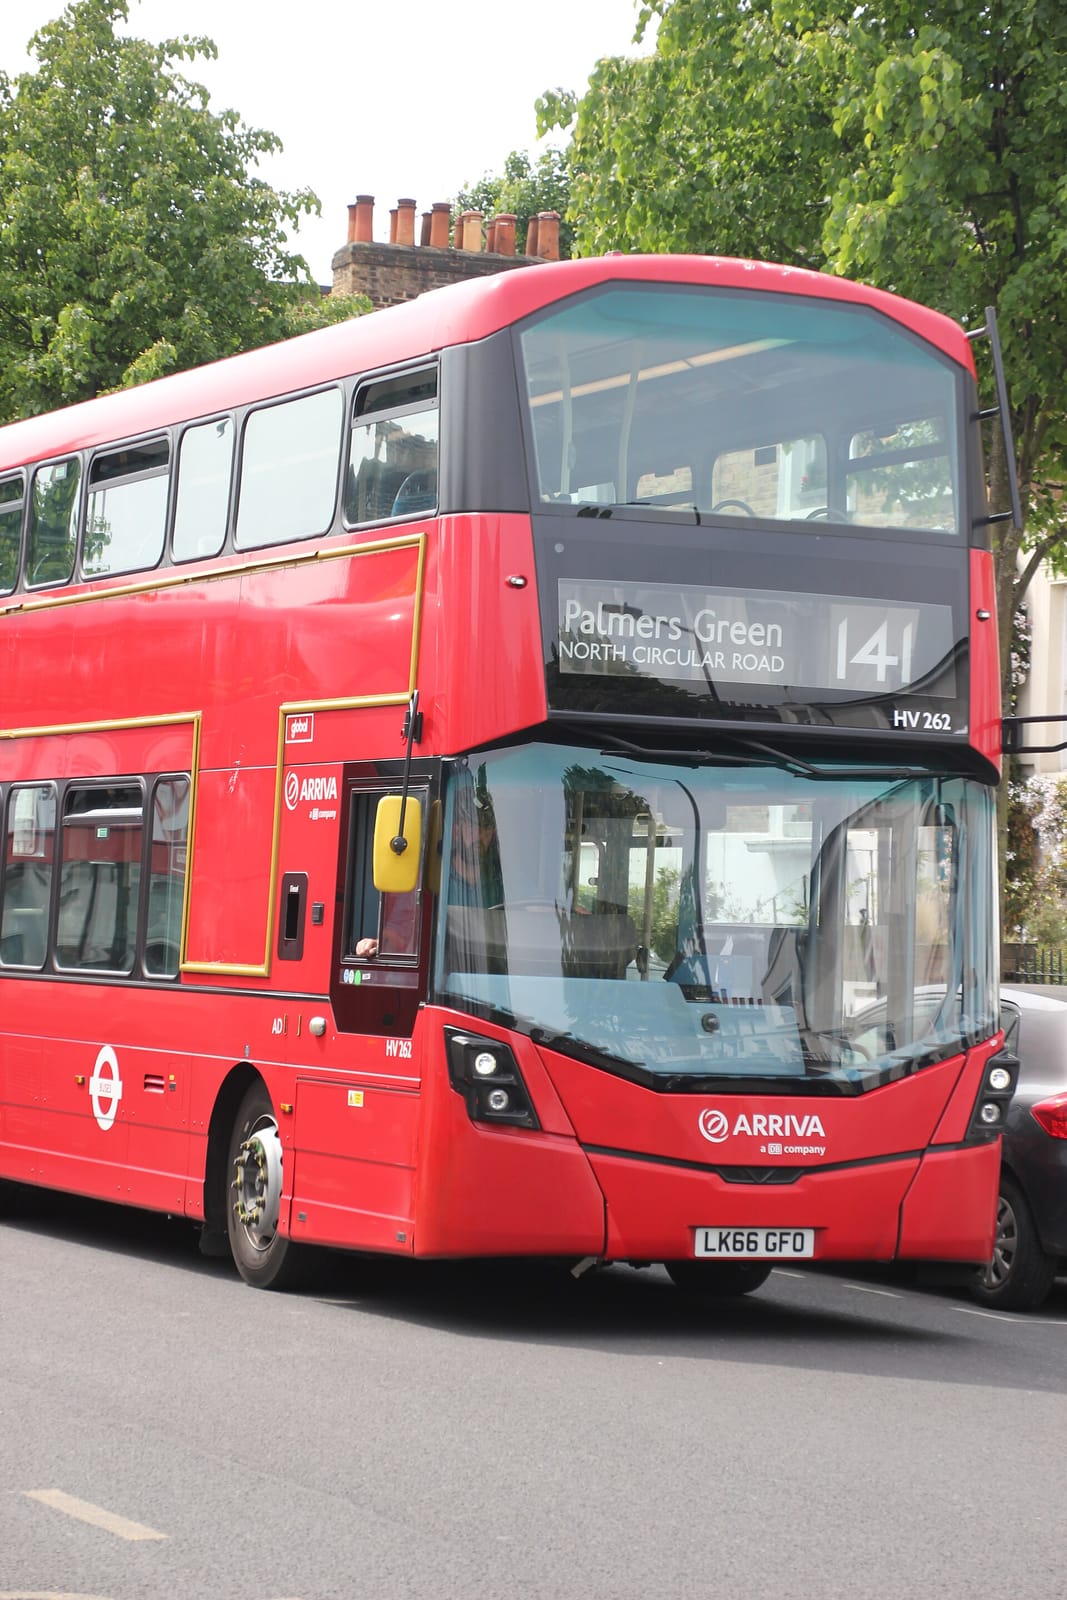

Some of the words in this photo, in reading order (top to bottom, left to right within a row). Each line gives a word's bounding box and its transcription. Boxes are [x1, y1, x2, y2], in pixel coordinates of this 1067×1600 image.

[565, 600, 681, 641] Palmers
[694, 609, 782, 647] Green
[559, 641, 626, 662] NORTH
[632, 646, 725, 669] CIRCULAR
[732, 654, 785, 672] ROAD
[836, 617, 913, 683] 141
[893, 710, 920, 728] HV
[923, 712, 951, 730] 262
[299, 777, 337, 801] ARRIVA
[271, 1018, 283, 1034] AD
[385, 1039, 398, 1057] HV
[398, 1040, 412, 1058] 262
[732, 1114, 826, 1137] ARRIVA
[760, 1145, 766, 1153] a
[784, 1145, 826, 1156] company
[704, 1231, 759, 1252] LK66
[765, 1231, 805, 1252] GFO
